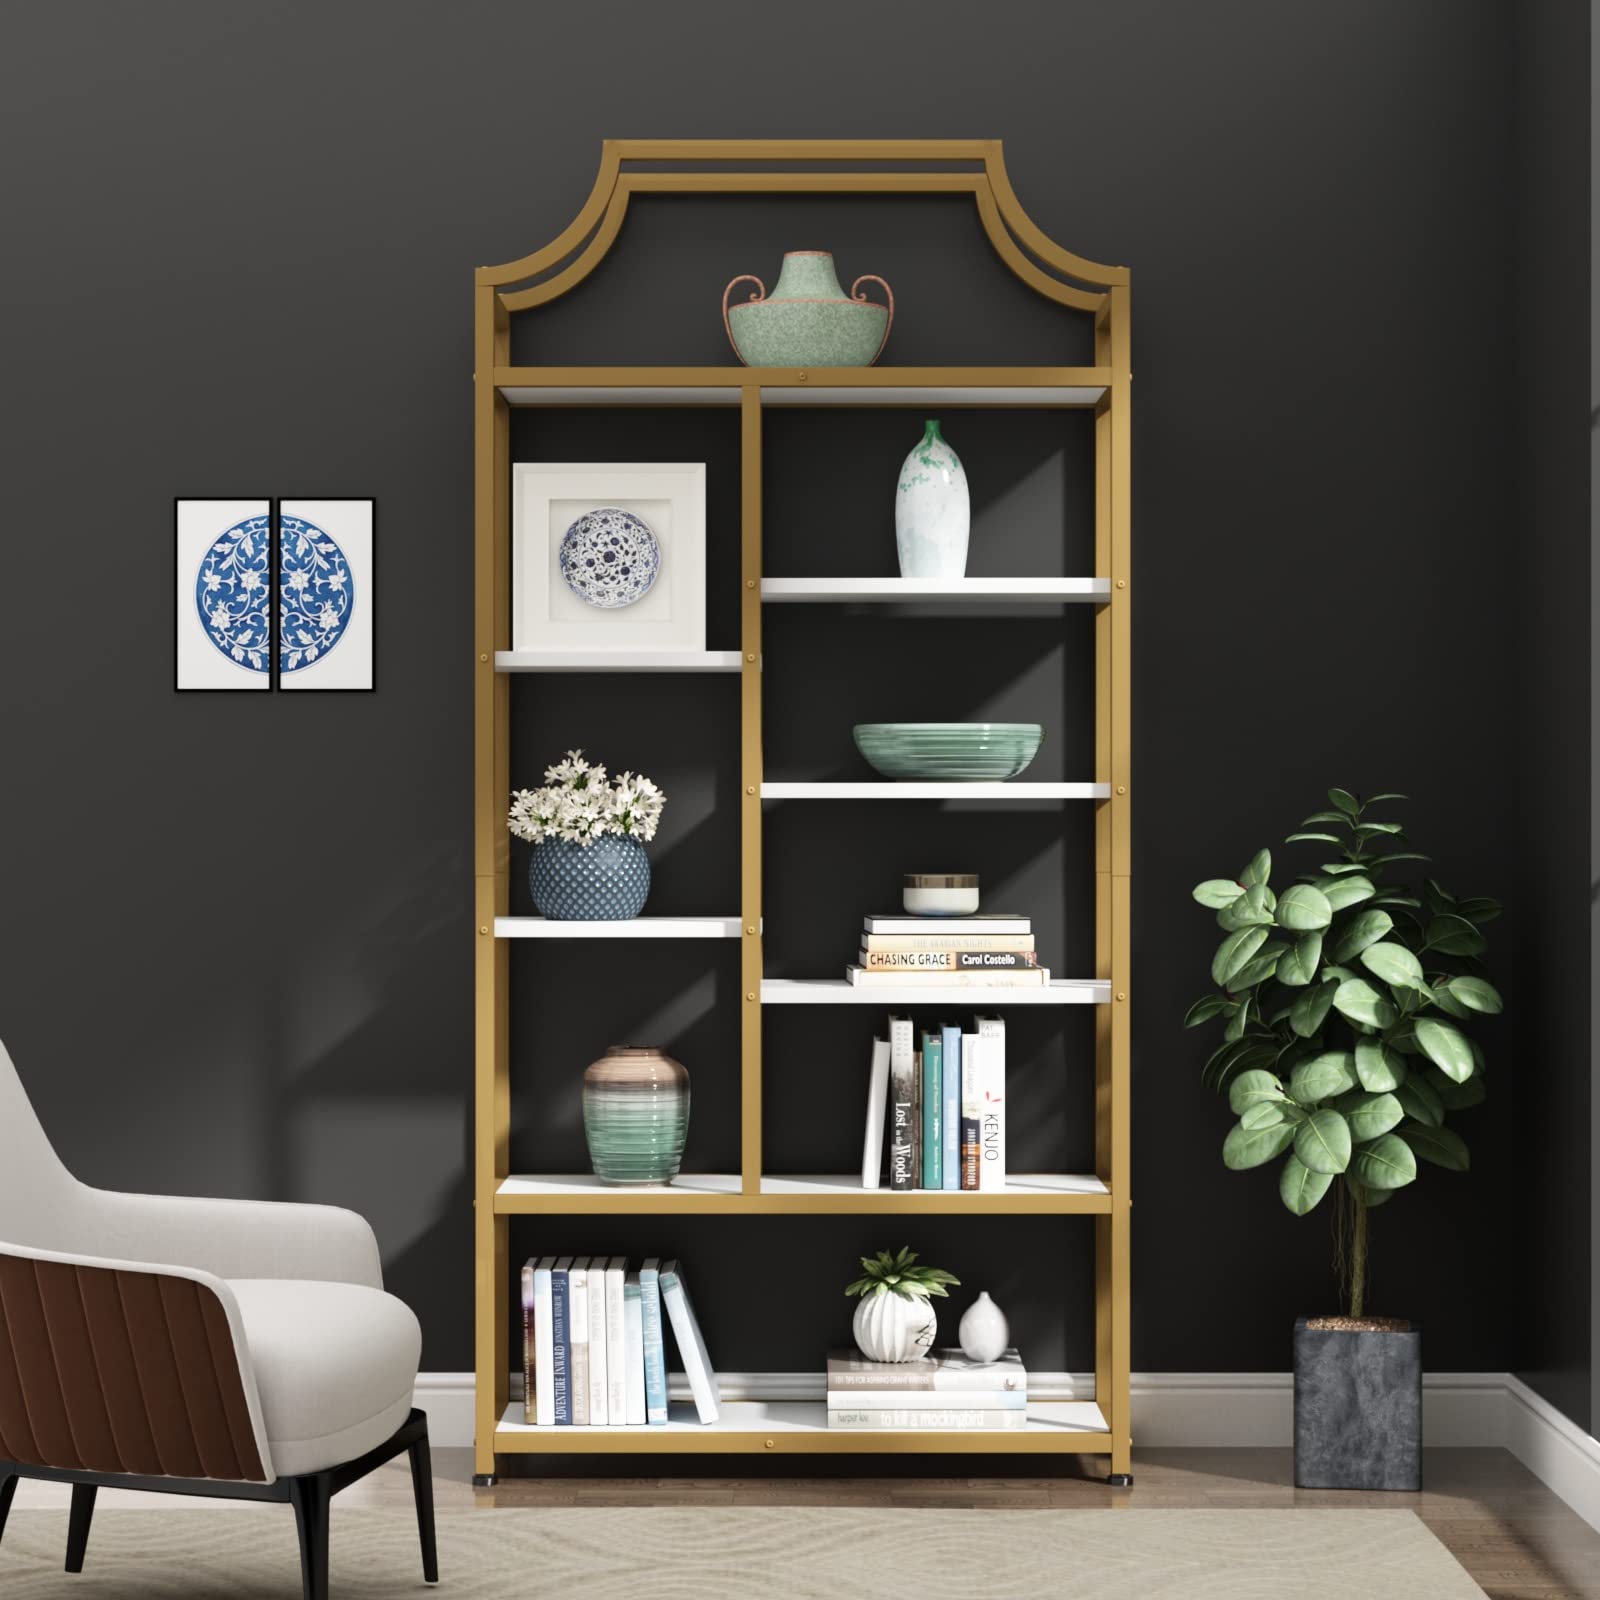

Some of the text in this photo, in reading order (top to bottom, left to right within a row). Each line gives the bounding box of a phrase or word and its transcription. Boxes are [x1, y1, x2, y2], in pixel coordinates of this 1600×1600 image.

[870, 953, 951, 965] CHASING GRACE
[962, 954, 1015, 965] Carol Costello
[896, 1102, 912, 1127] Lost
[984, 1114, 999, 1161] KENJO
[896, 1144, 912, 1184] Woods
[554, 1318, 564, 1344] JONATHAN
[554, 1345, 567, 1421] ADVENTURE INWARD
[838, 1412, 858, 1424] harper
[880, 1410, 985, 1428] to kill a mockingbird
